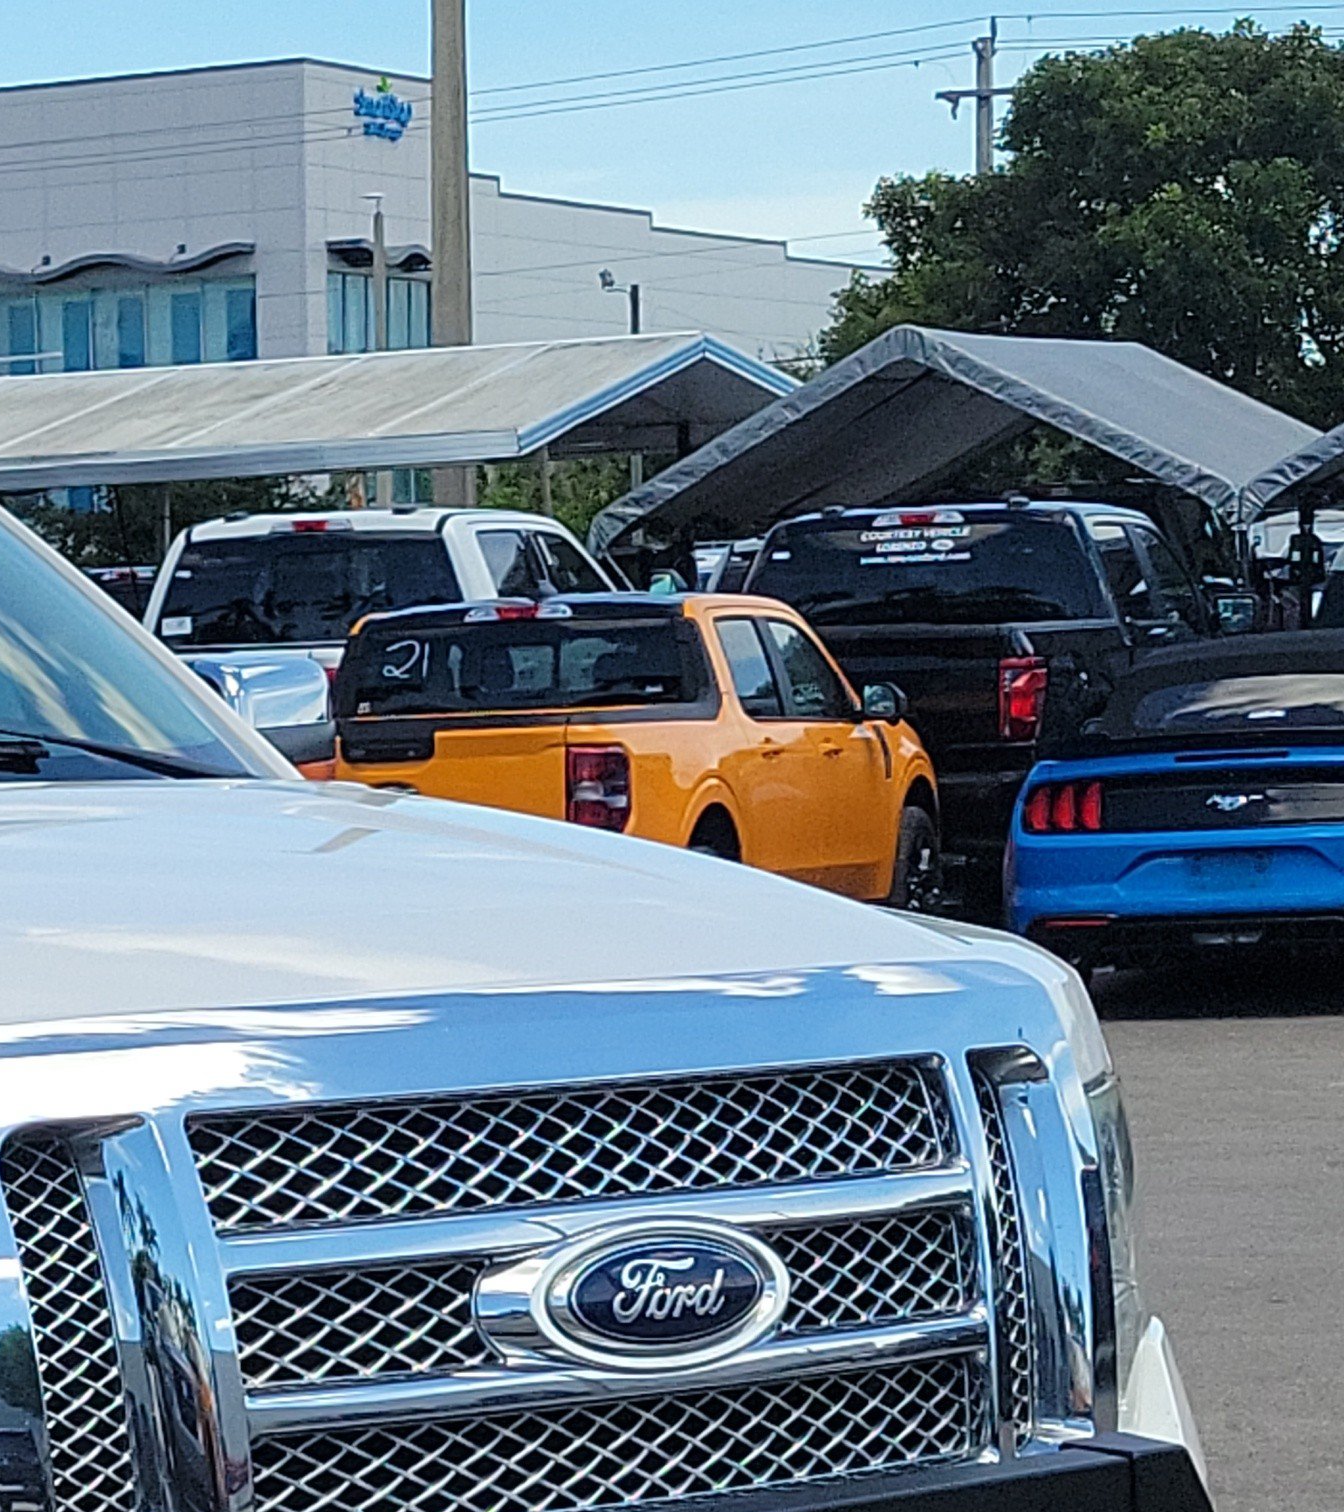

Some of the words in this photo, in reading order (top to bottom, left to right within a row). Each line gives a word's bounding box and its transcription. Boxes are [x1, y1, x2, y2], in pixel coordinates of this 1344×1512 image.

[860, 529, 922, 542] COURTESY
[923, 525, 971, 538] VEHICLE
[382, 639, 430, 679] 21
[613, 1257, 724, 1323] Ford
